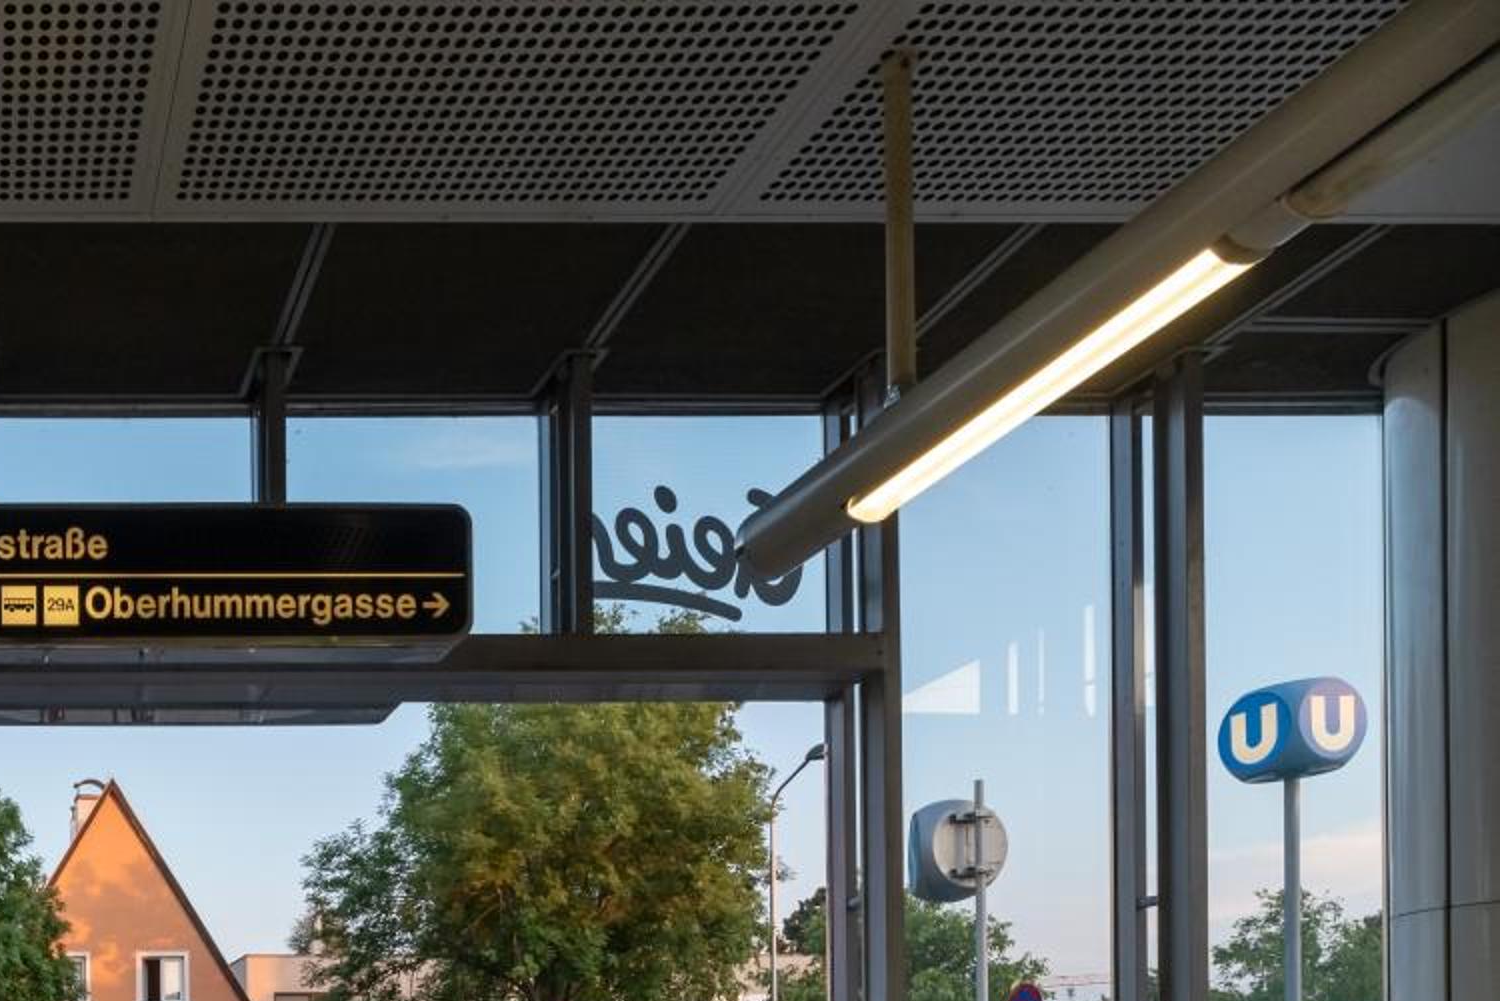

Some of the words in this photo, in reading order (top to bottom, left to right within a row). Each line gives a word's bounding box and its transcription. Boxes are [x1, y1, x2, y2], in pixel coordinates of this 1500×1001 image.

[48, 599, 74, 611] 29A
[85, 586, 416, 626] Oberhummergasse
[1229, 702, 1279, 765] U
[1309, 695, 1356, 753] U
